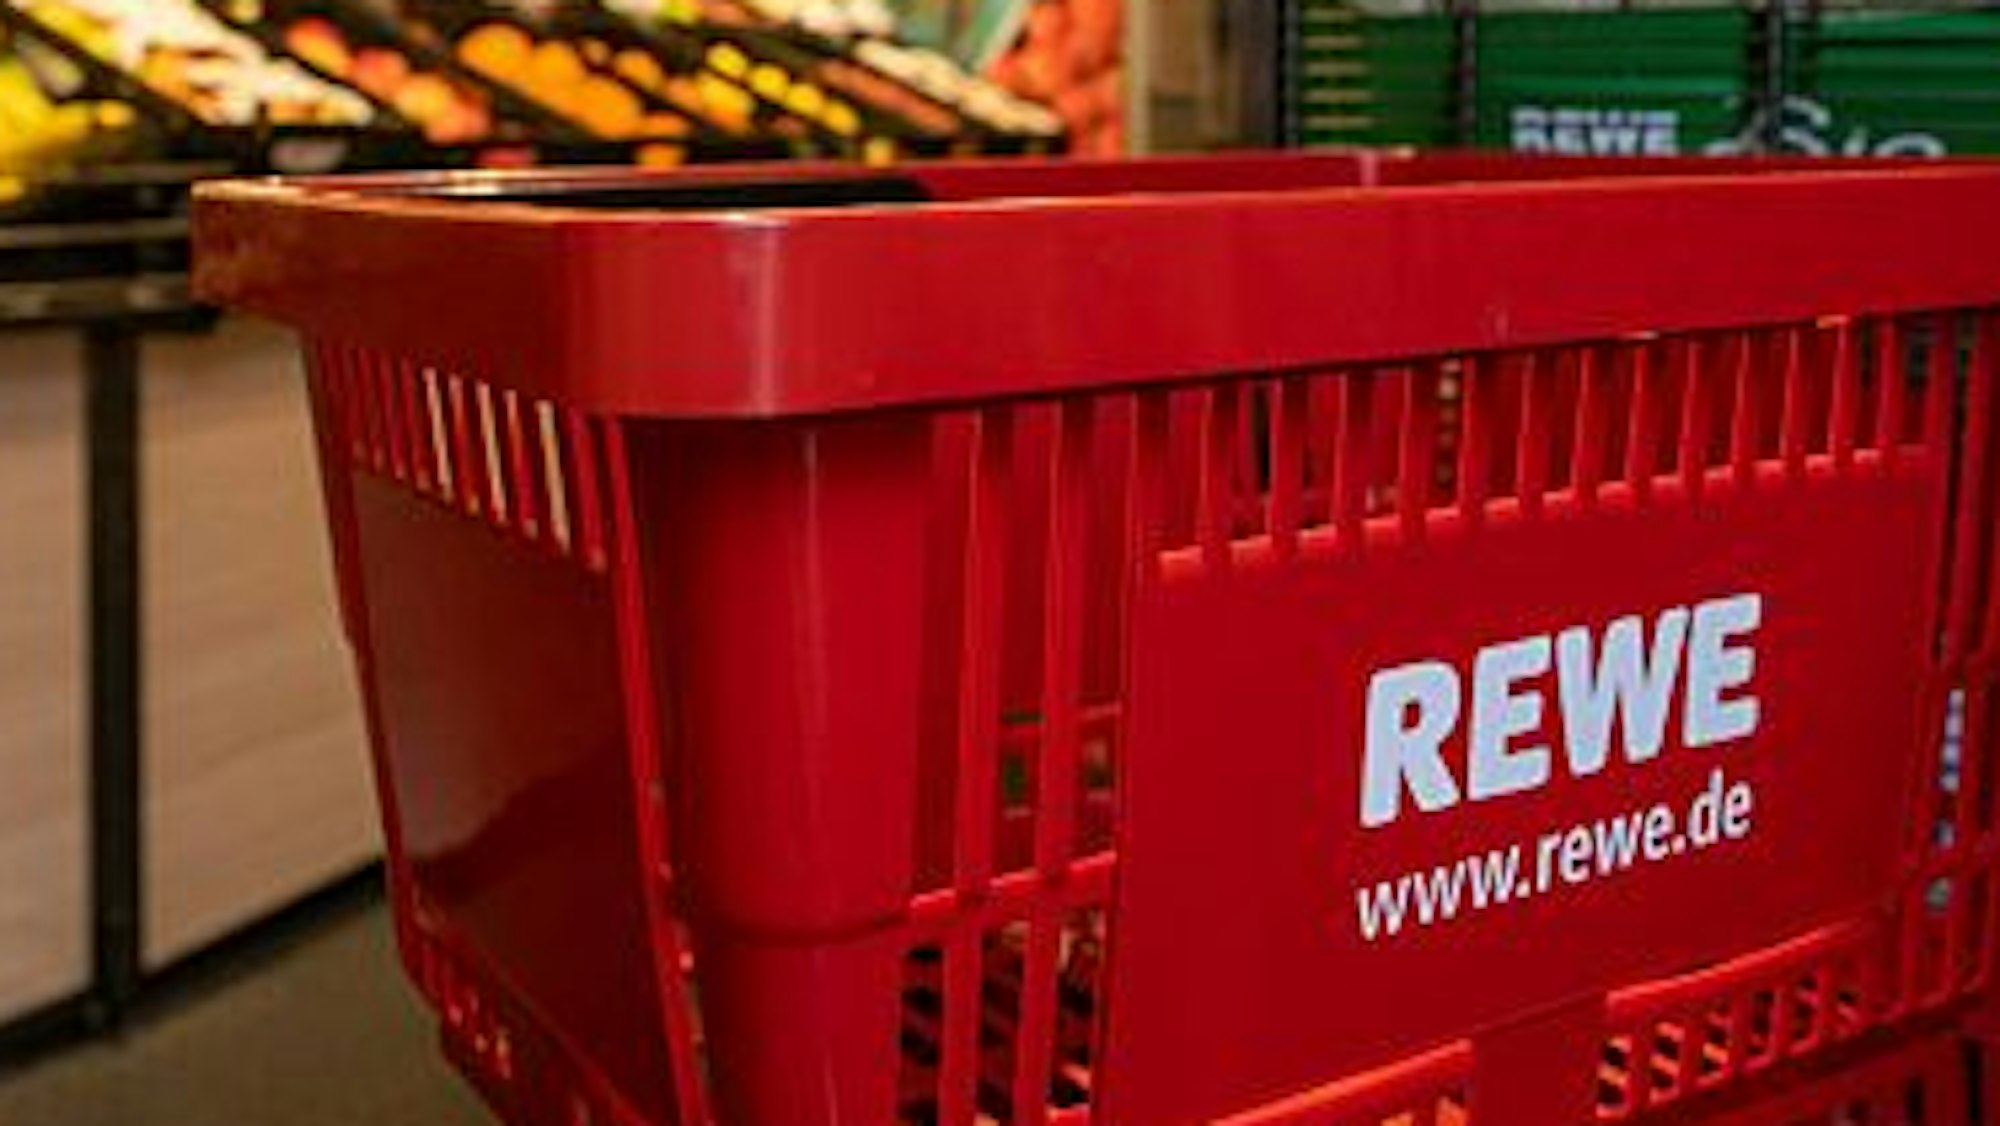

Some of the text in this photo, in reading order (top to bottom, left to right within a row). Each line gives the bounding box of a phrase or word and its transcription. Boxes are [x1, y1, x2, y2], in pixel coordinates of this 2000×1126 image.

[1511, 108, 1678, 156] REWE
[1359, 592, 1763, 829] REWE
[1355, 767, 1752, 942] www.rewe.de
